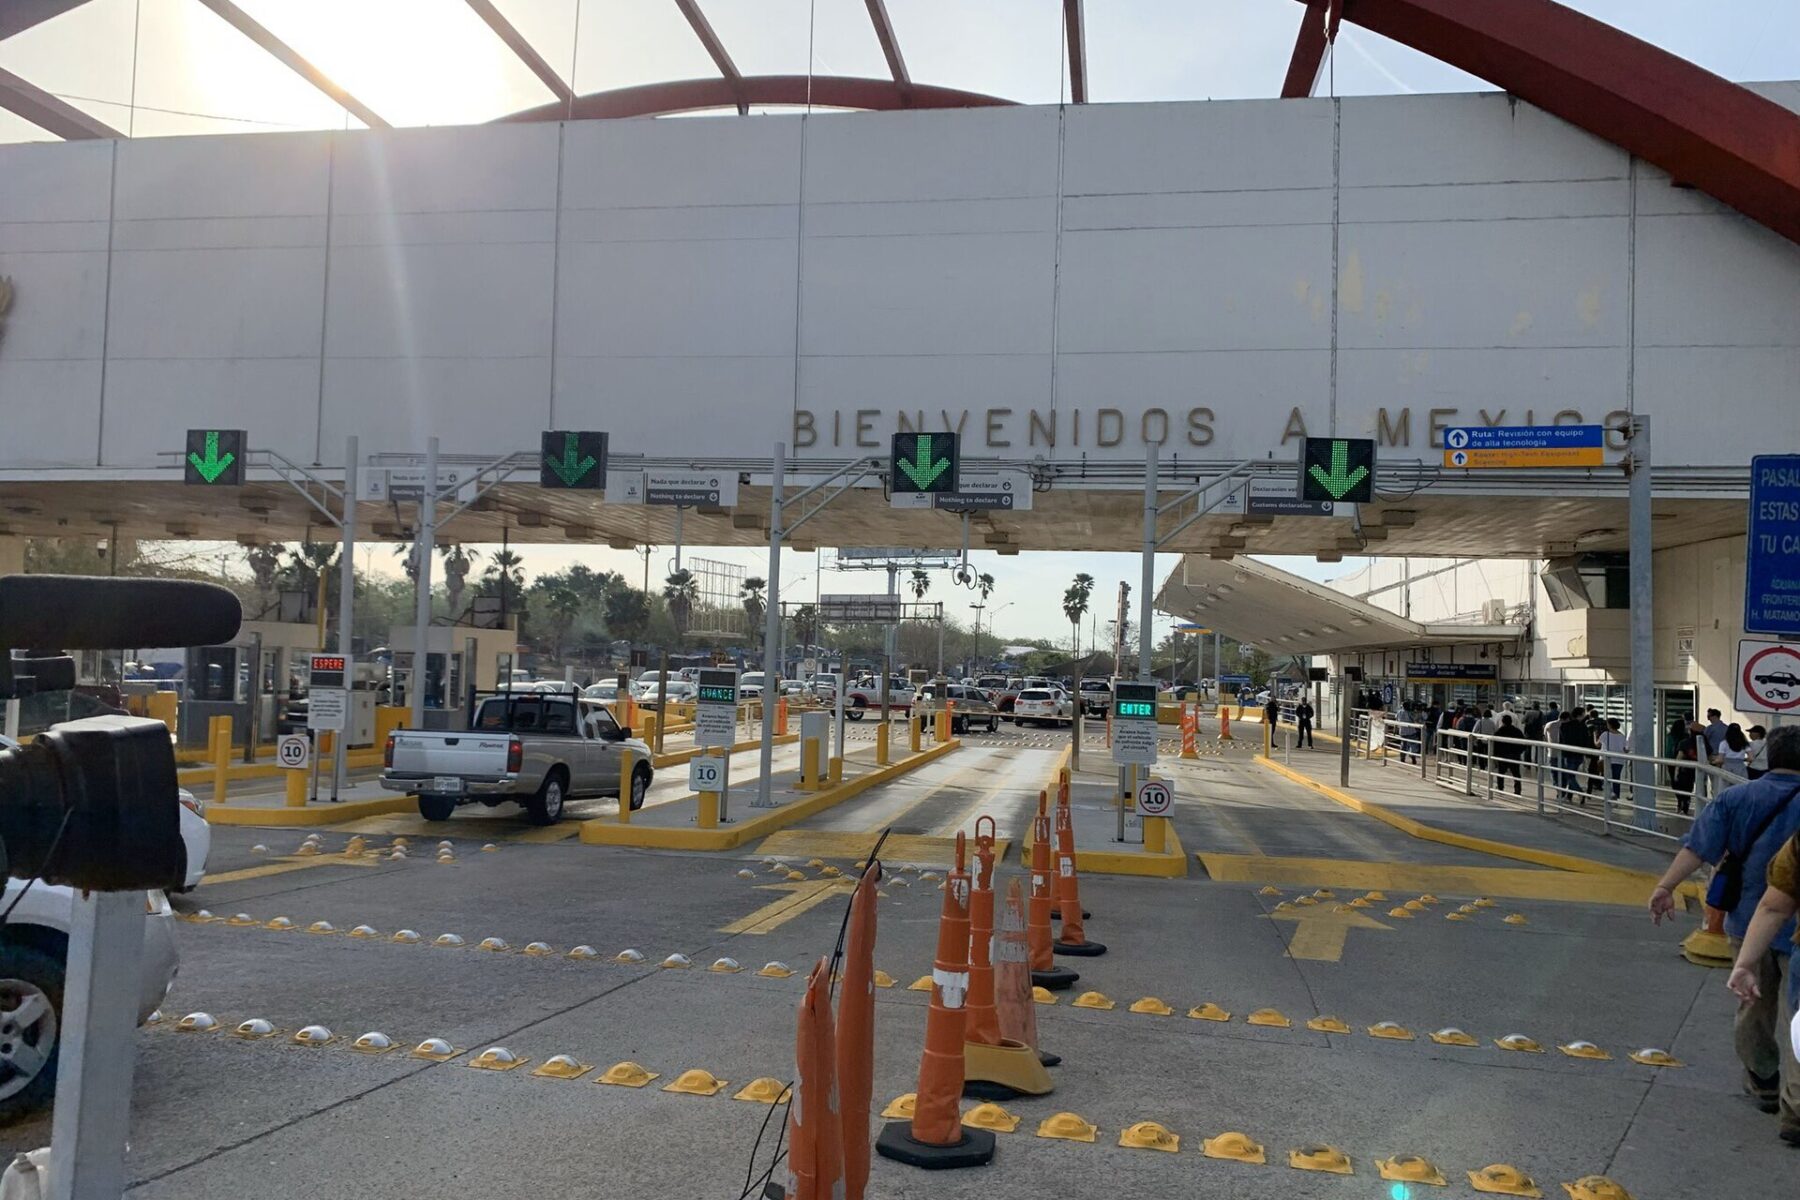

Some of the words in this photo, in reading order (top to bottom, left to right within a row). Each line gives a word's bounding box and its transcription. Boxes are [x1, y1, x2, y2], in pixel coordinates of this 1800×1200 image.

[794, 407, 1215, 448] BIENVENIDOS
[1280, 407, 1309, 446] A
[1498, 429, 1534, 438] Revisión
[1555, 430, 1584, 438] equipo
[1760, 501, 1799, 521] ESTAS
[1760, 534, 1777, 554] TU
[313, 658, 344, 670] ESPERE
[1120, 702, 1151, 716] ENTER
[284, 746, 301, 757] 10
[697, 768, 716, 780] 10
[1144, 792, 1164, 804] 10
